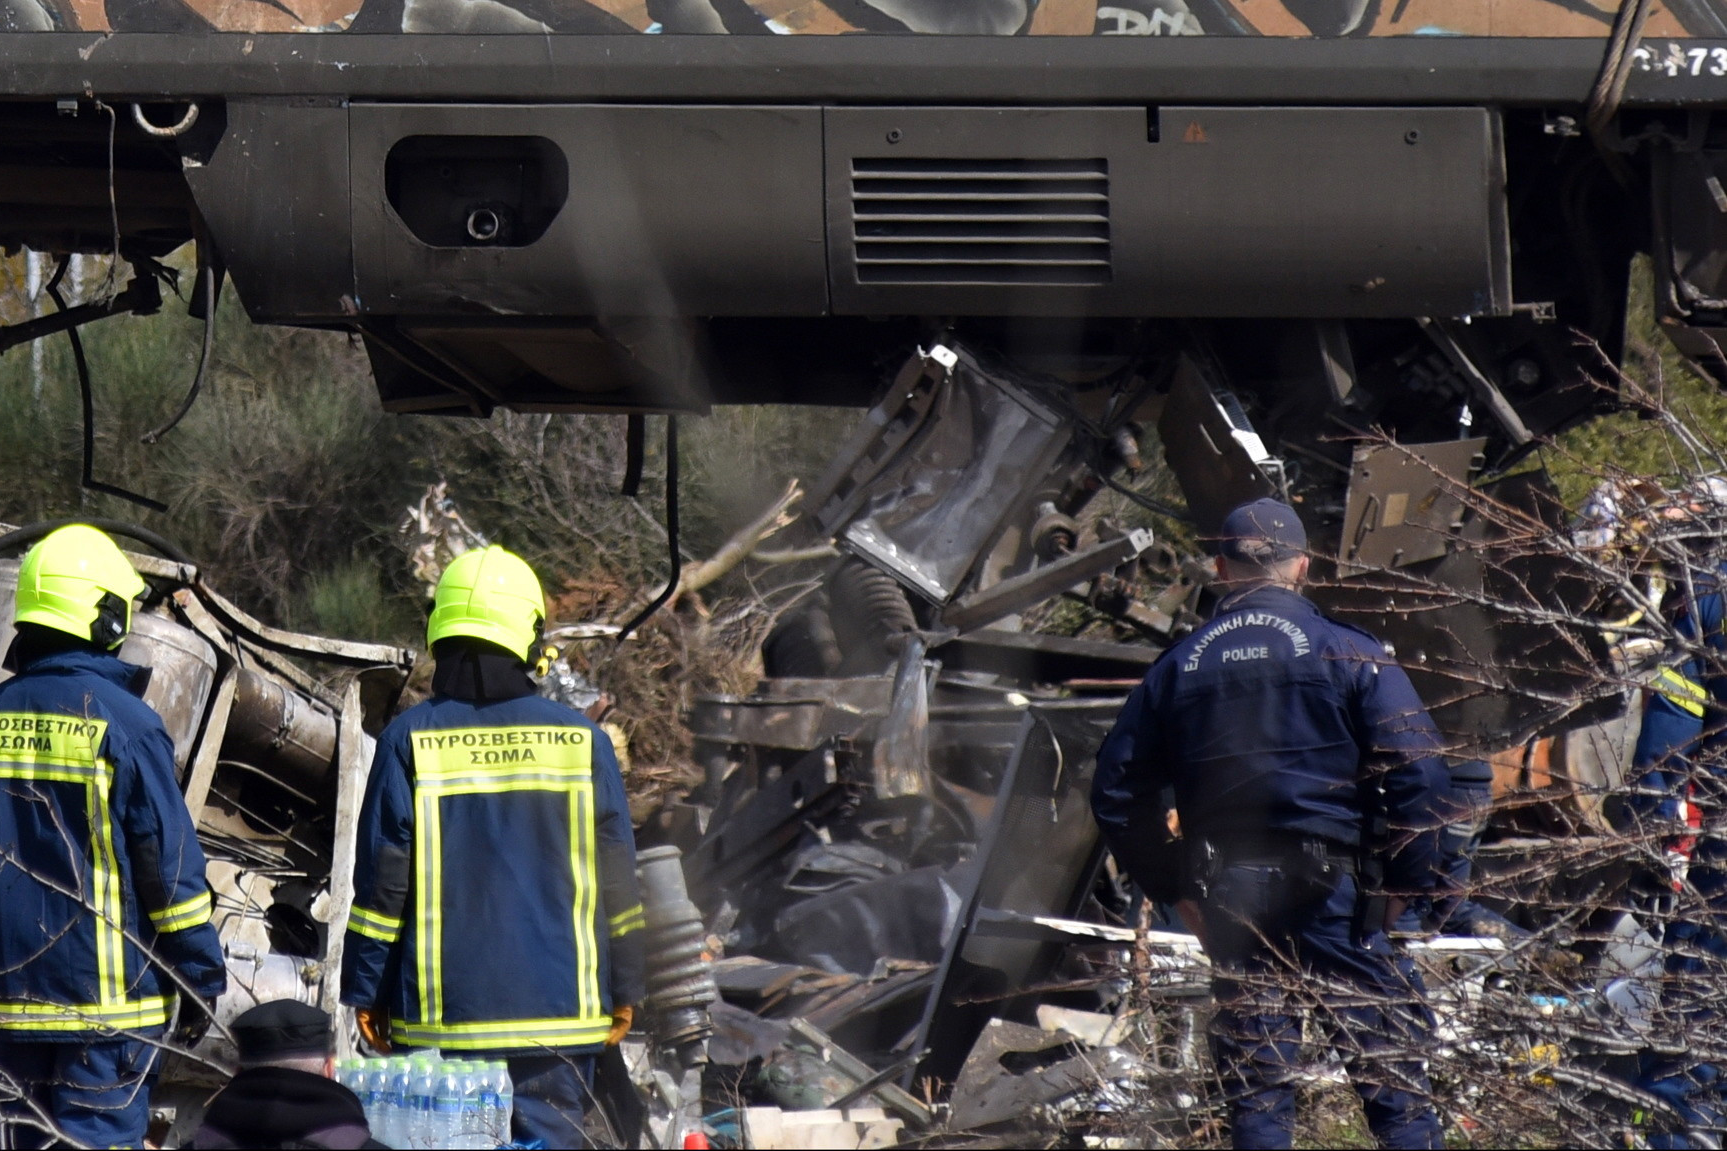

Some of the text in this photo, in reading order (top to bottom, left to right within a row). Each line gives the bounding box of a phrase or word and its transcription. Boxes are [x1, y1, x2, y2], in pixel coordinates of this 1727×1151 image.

[1184, 613, 1311, 672] ΕΛΛΗΝΙΚΗ ΑΣΤΥΝΟΜΙΑ
[1222, 647, 1268, 663] POLICE
[0, 735, 53, 752] ΣΩΜΑ
[419, 731, 585, 750] ΠΥΡΟΣΒΕΣΤΙΚΟ
[470, 748, 537, 765] ΣΩΜΑ
